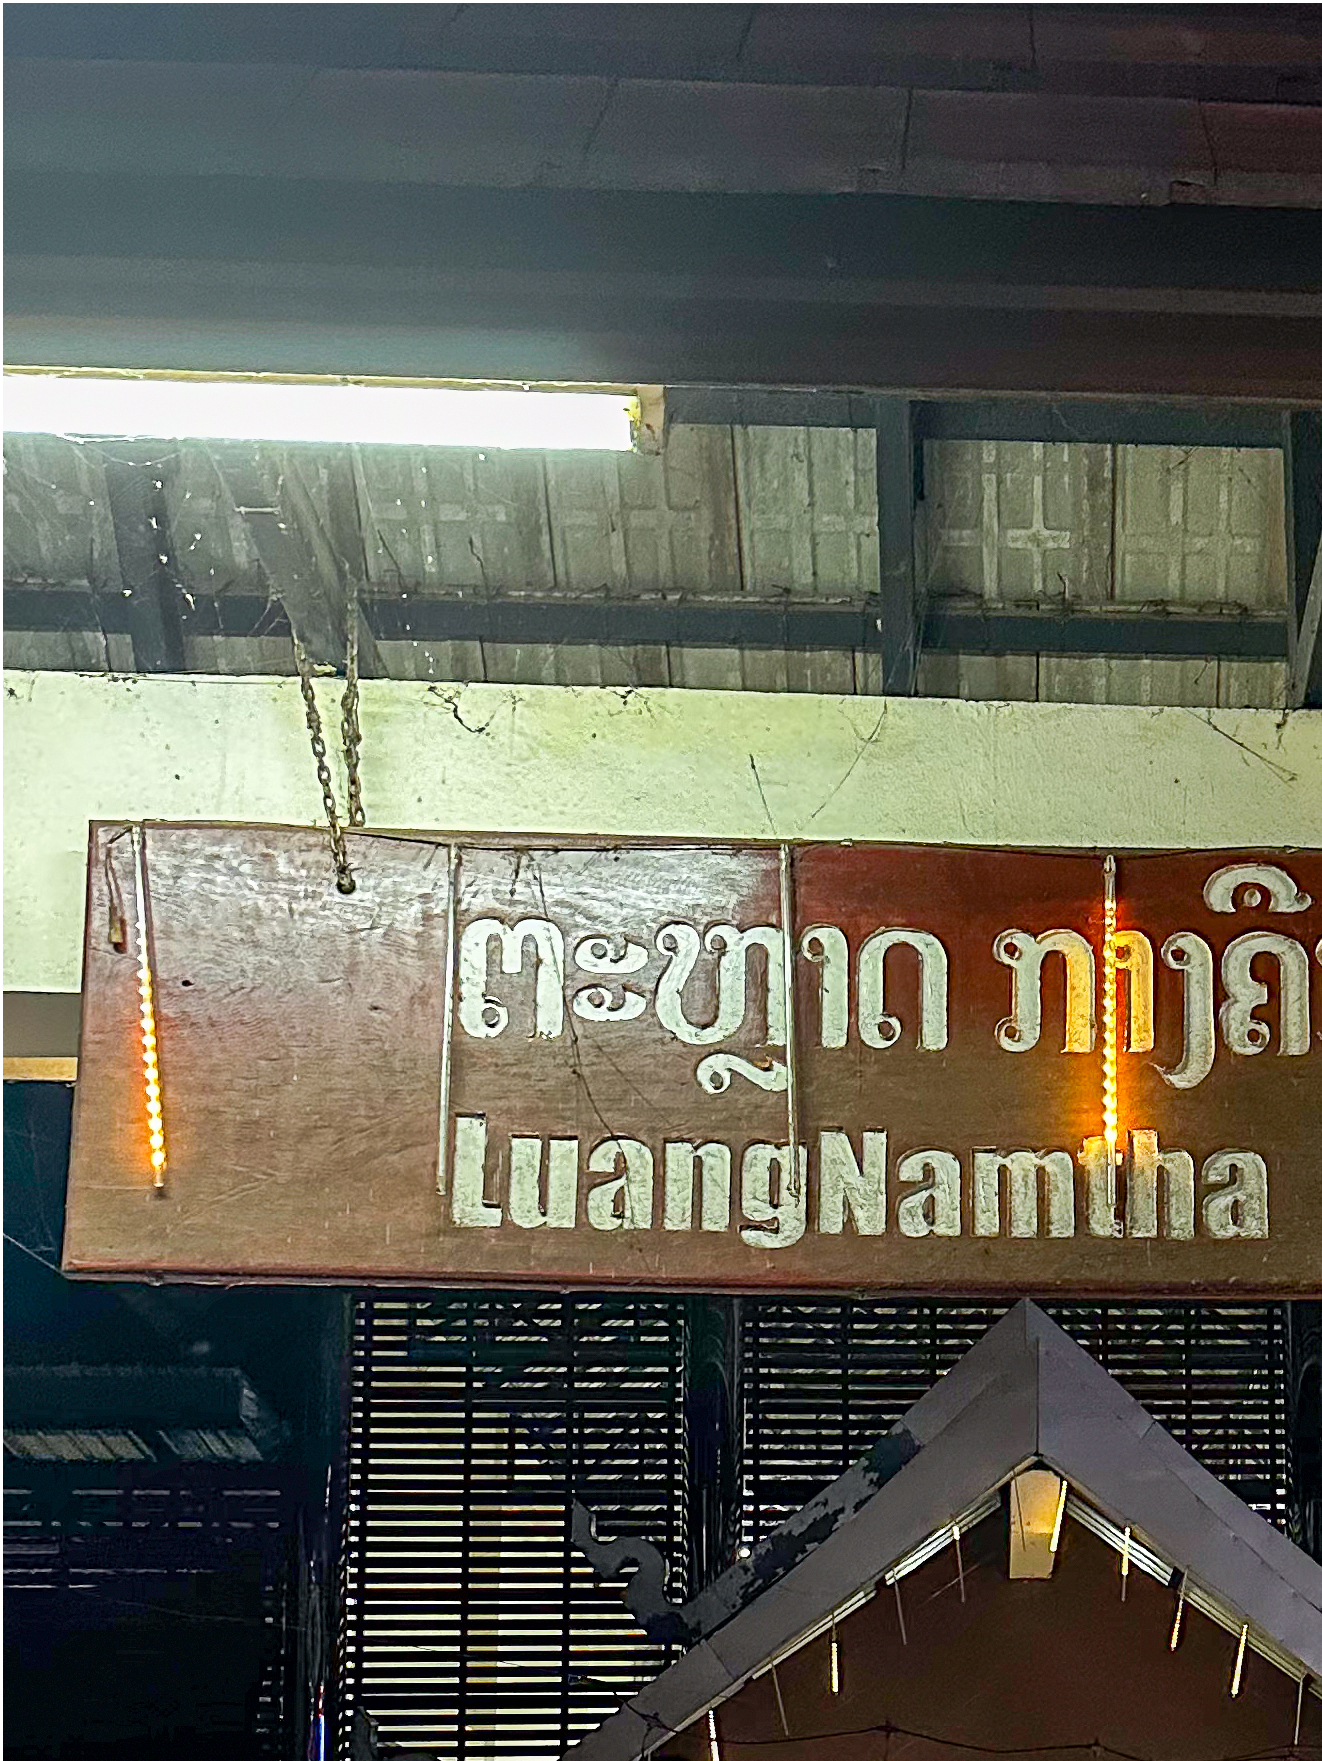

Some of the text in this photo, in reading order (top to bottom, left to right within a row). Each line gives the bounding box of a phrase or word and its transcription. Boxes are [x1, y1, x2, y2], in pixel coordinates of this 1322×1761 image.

[458, 916, 949, 1096] ຕະຫຼາດ
[451, 1112, 1269, 1250] LuangNamtha
